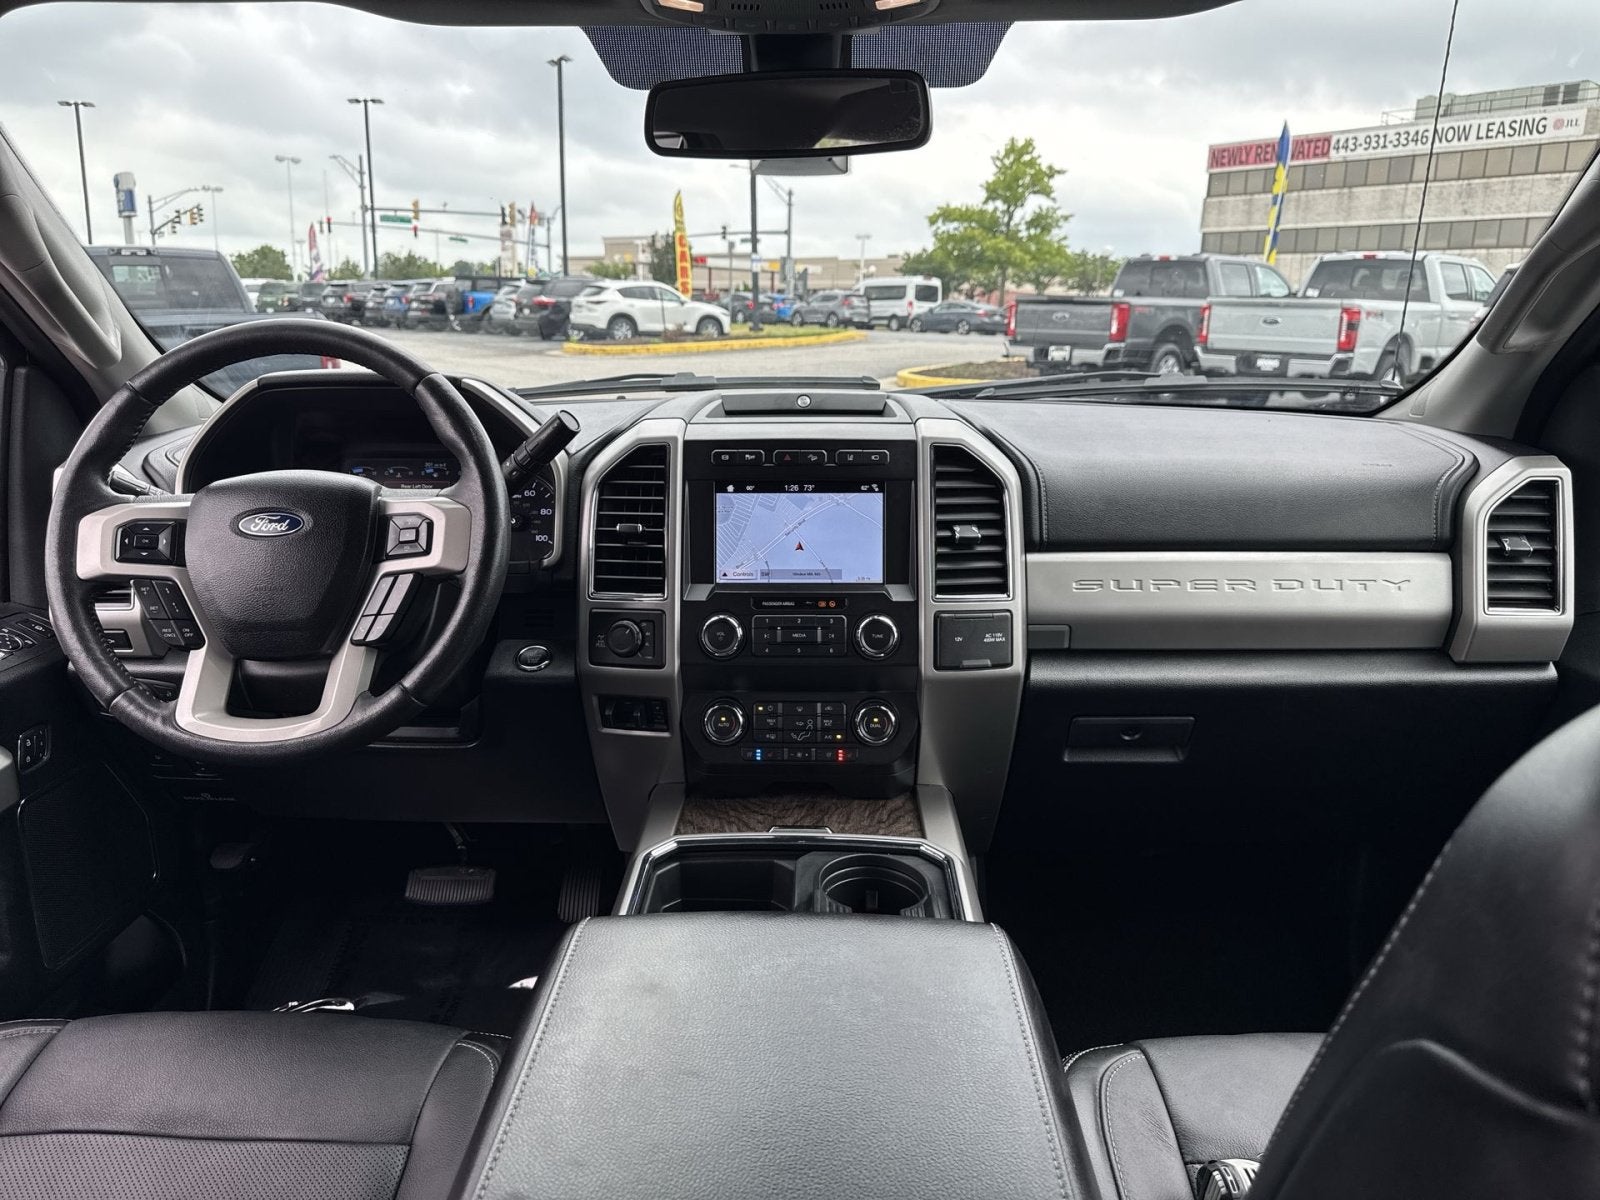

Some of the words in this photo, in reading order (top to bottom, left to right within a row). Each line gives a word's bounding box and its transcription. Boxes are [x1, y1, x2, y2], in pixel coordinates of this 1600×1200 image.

[1210, 145, 1253, 168] NEWLY
[1254, 138, 1331, 164] RENVATED
[1332, 129, 1430, 153] 443-931-3346
[1433, 124, 1472, 144] NOW
[1475, 116, 1548, 141] LEASING
[784, 484, 799, 492] 1:26
[803, 484, 815, 492] 73°
[540, 508, 553, 516] 80
[250, 514, 290, 531] Ford
[535, 534, 549, 542] 100
[1072, 578, 1257, 593] SUPER
[1271, 578, 1412, 593] DUTY
